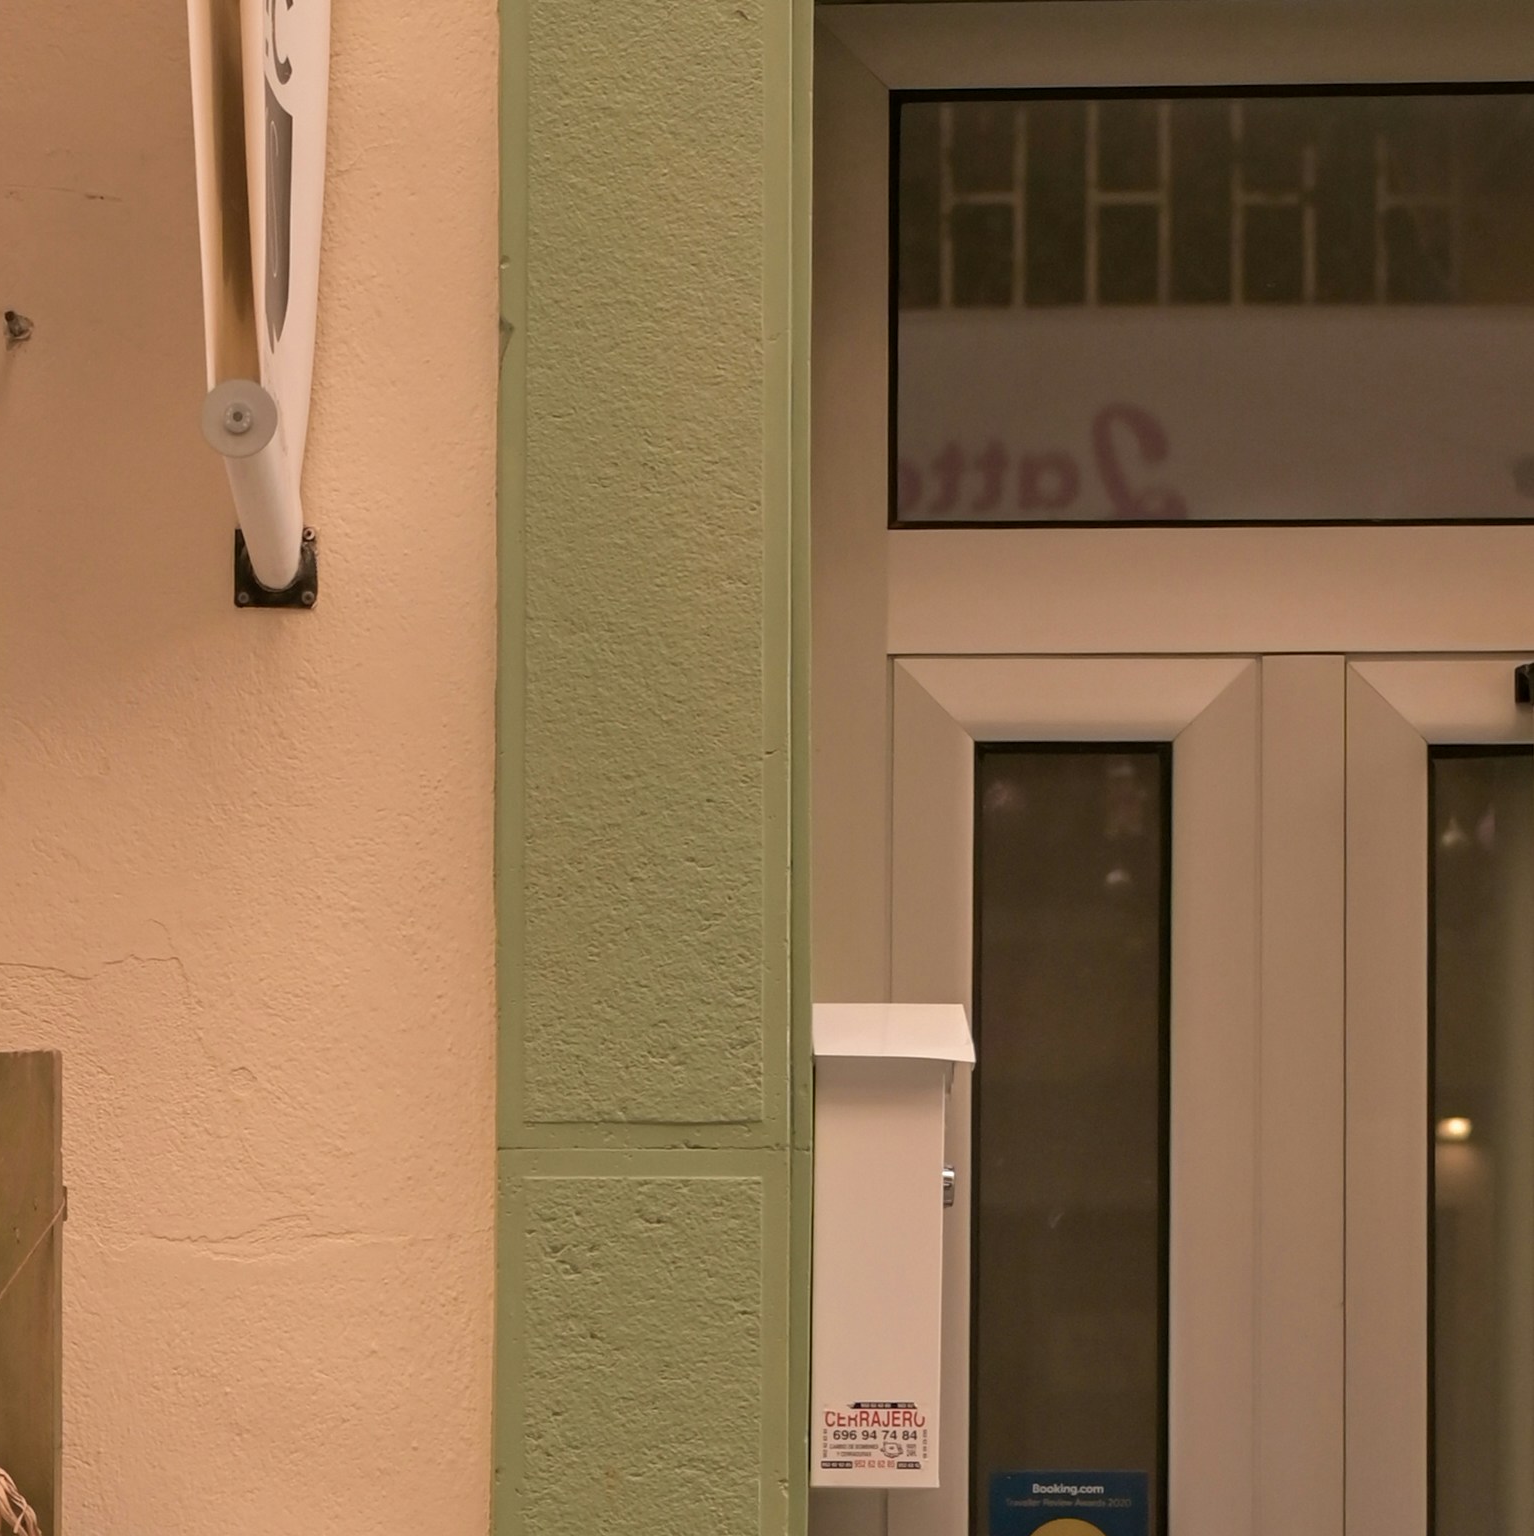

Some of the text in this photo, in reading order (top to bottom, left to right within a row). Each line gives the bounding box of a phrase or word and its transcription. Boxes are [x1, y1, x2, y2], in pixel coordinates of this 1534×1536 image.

[825, 1411, 925, 1427] CERRAJERO
[833, 1429, 918, 1441] 696 94 74 84
[1032, 1483, 1104, 1496] Booking.com
